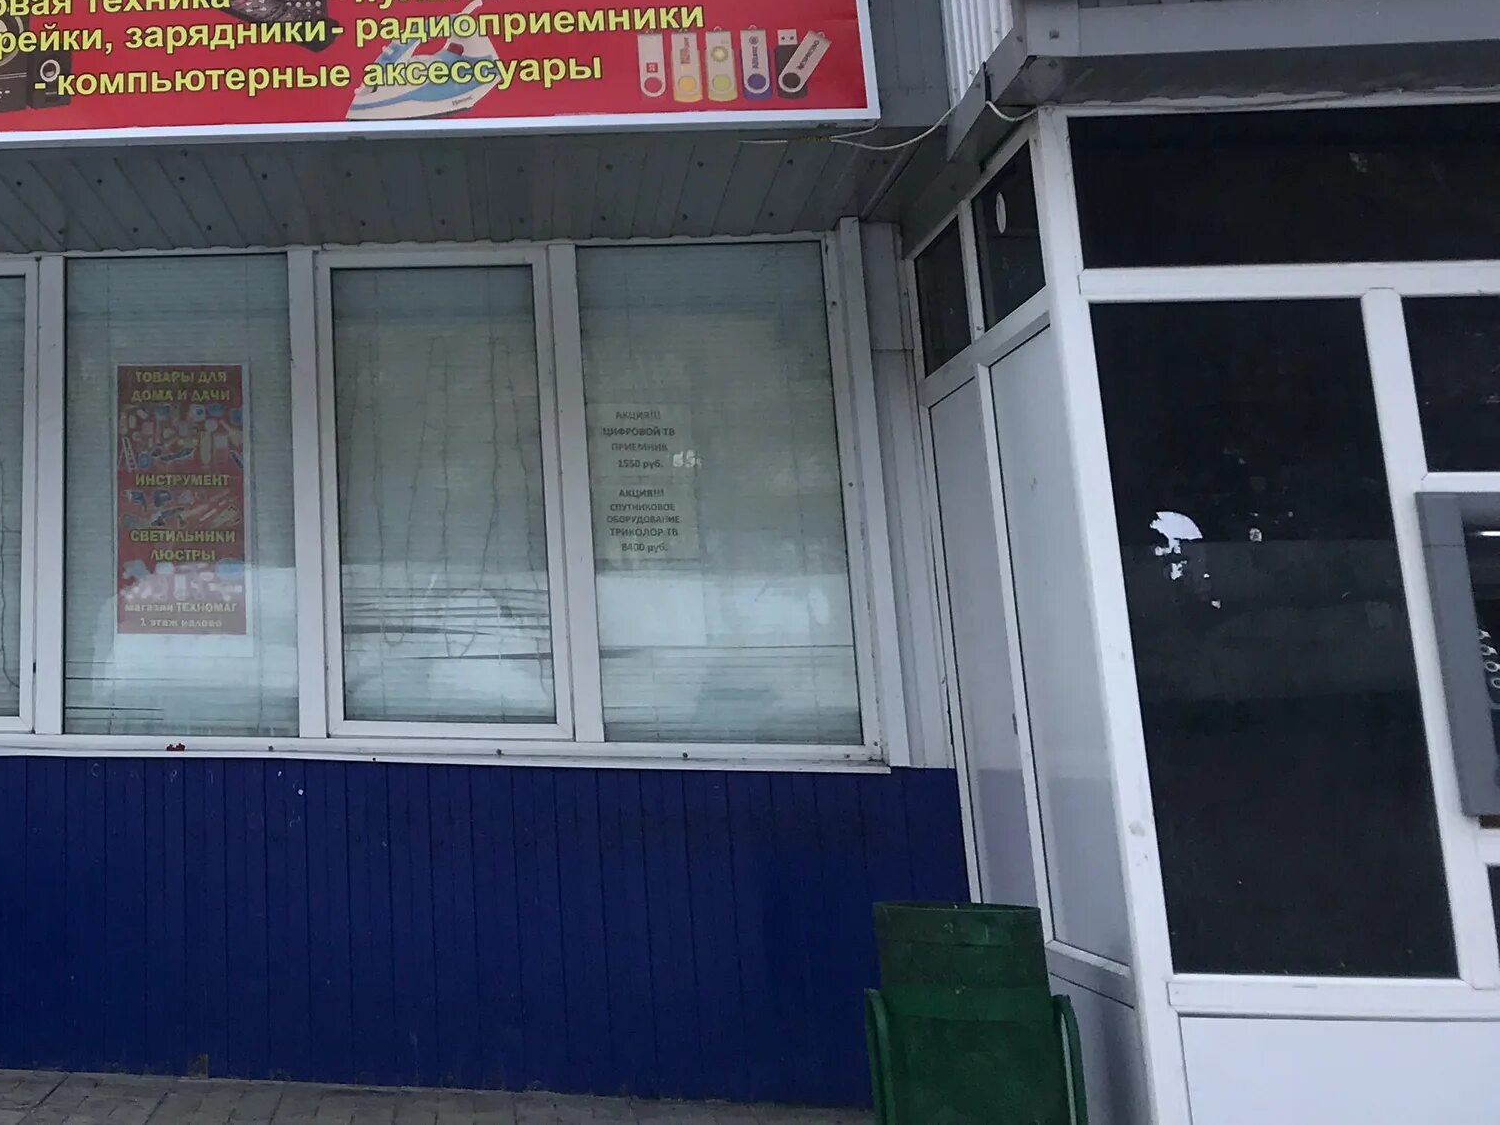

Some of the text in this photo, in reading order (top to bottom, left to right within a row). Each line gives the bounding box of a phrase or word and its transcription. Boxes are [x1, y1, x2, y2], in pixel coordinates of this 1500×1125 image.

[356, 4, 705, 43] радиоприемники
[125, 17, 328, 50] зарядники
[57, 65, 352, 100] компьютерные
[364, 53, 602, 90] аксессуары
[134, 371, 227, 384] ТОВАРЫ ДЛЯ
[131, 389, 230, 402] ДОМА И ДАЧИ
[603, 427, 675, 437] ЦИФРОВОЙ ТВ
[612, 443, 668, 452] ПРИЕМНИК
[643, 460, 663, 469] руб.
[135, 474, 230, 486] ИНСТРУМЕНТ
[610, 504, 675, 512] СПУТНИКОВОЕ
[607, 516, 680, 524] ОБОРУДОВАНИЕ
[131, 530, 236, 543] СВЕТИЛЬНИКИ
[610, 528, 678, 536] ТРИКОЛОР ТВ
[150, 549, 216, 562] ЛЮСТРЫ
[176, 603, 237, 613] ТЕХНОМАГ
